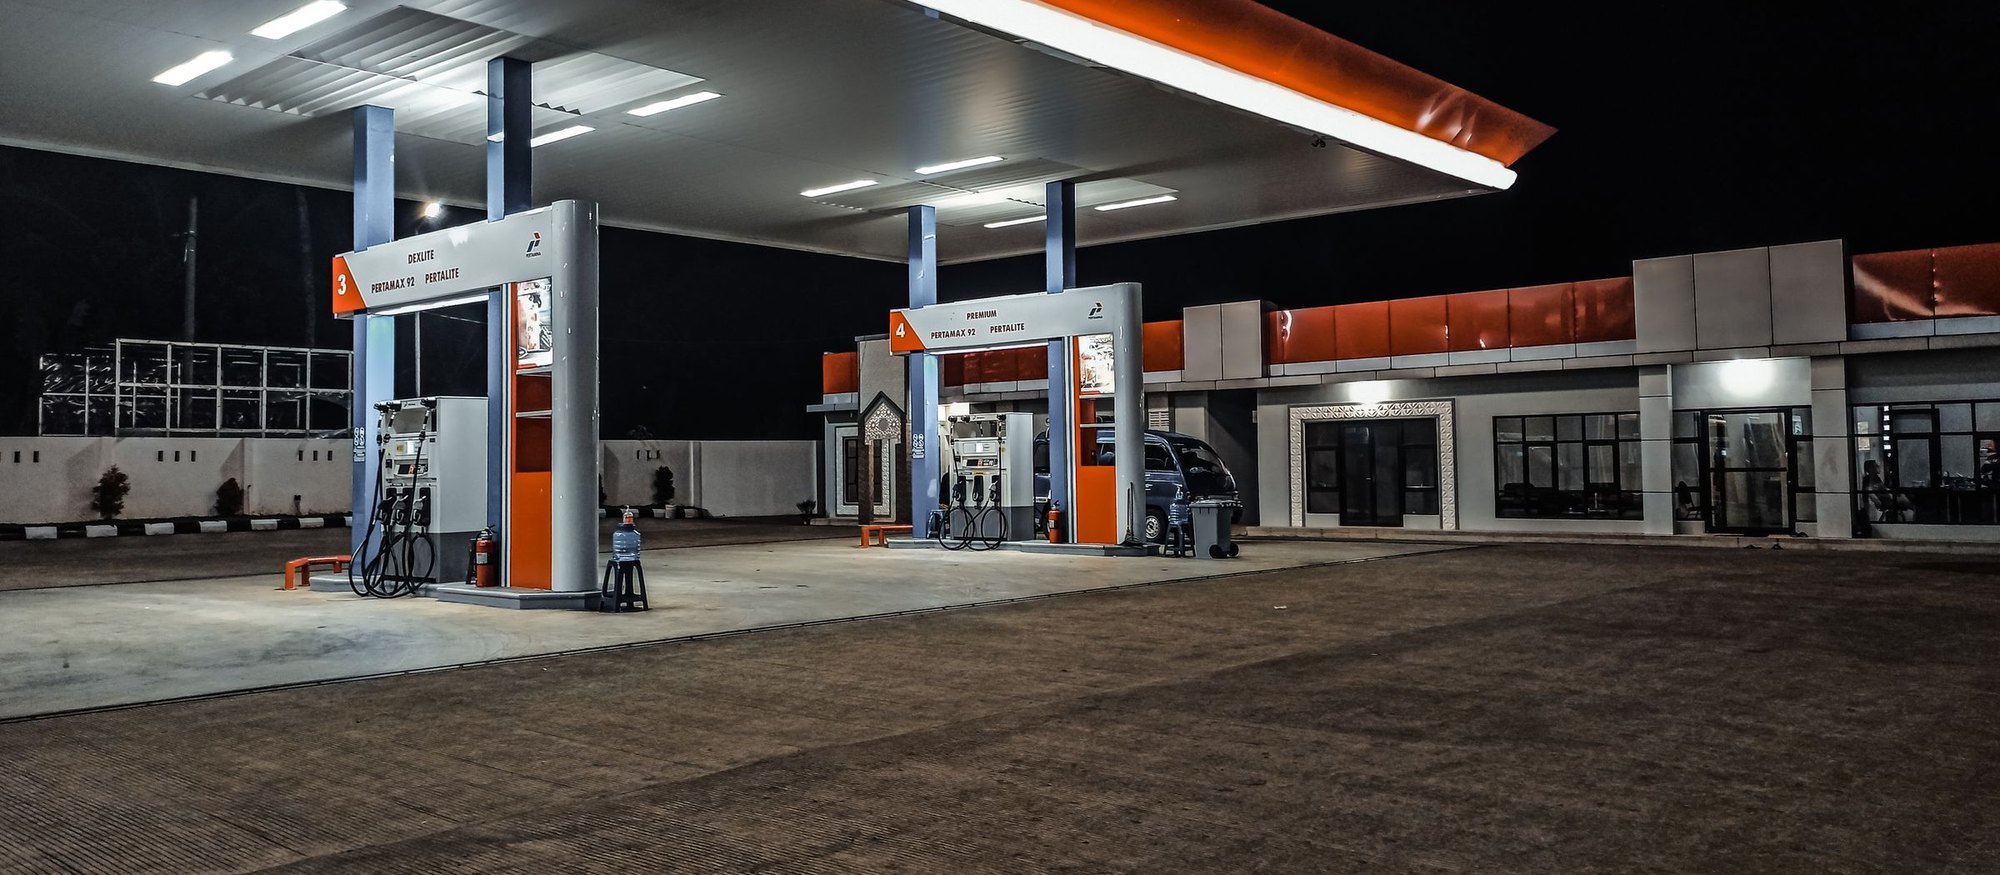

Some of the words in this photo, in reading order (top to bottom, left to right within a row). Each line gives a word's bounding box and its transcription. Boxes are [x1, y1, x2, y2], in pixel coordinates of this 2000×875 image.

[408, 249, 435, 264] DEXLITE
[337, 274, 347, 295] 3
[371, 278, 405, 294] PERTAMAX
[406, 276, 415, 287] 92
[425, 267, 460, 284] PERTALITE
[966, 309, 997, 320] PREMIUM
[895, 323, 906, 338] 4
[930, 329, 966, 339] PERTAMAX
[967, 328, 976, 336] 92
[989, 322, 1025, 333] PERTALITE
